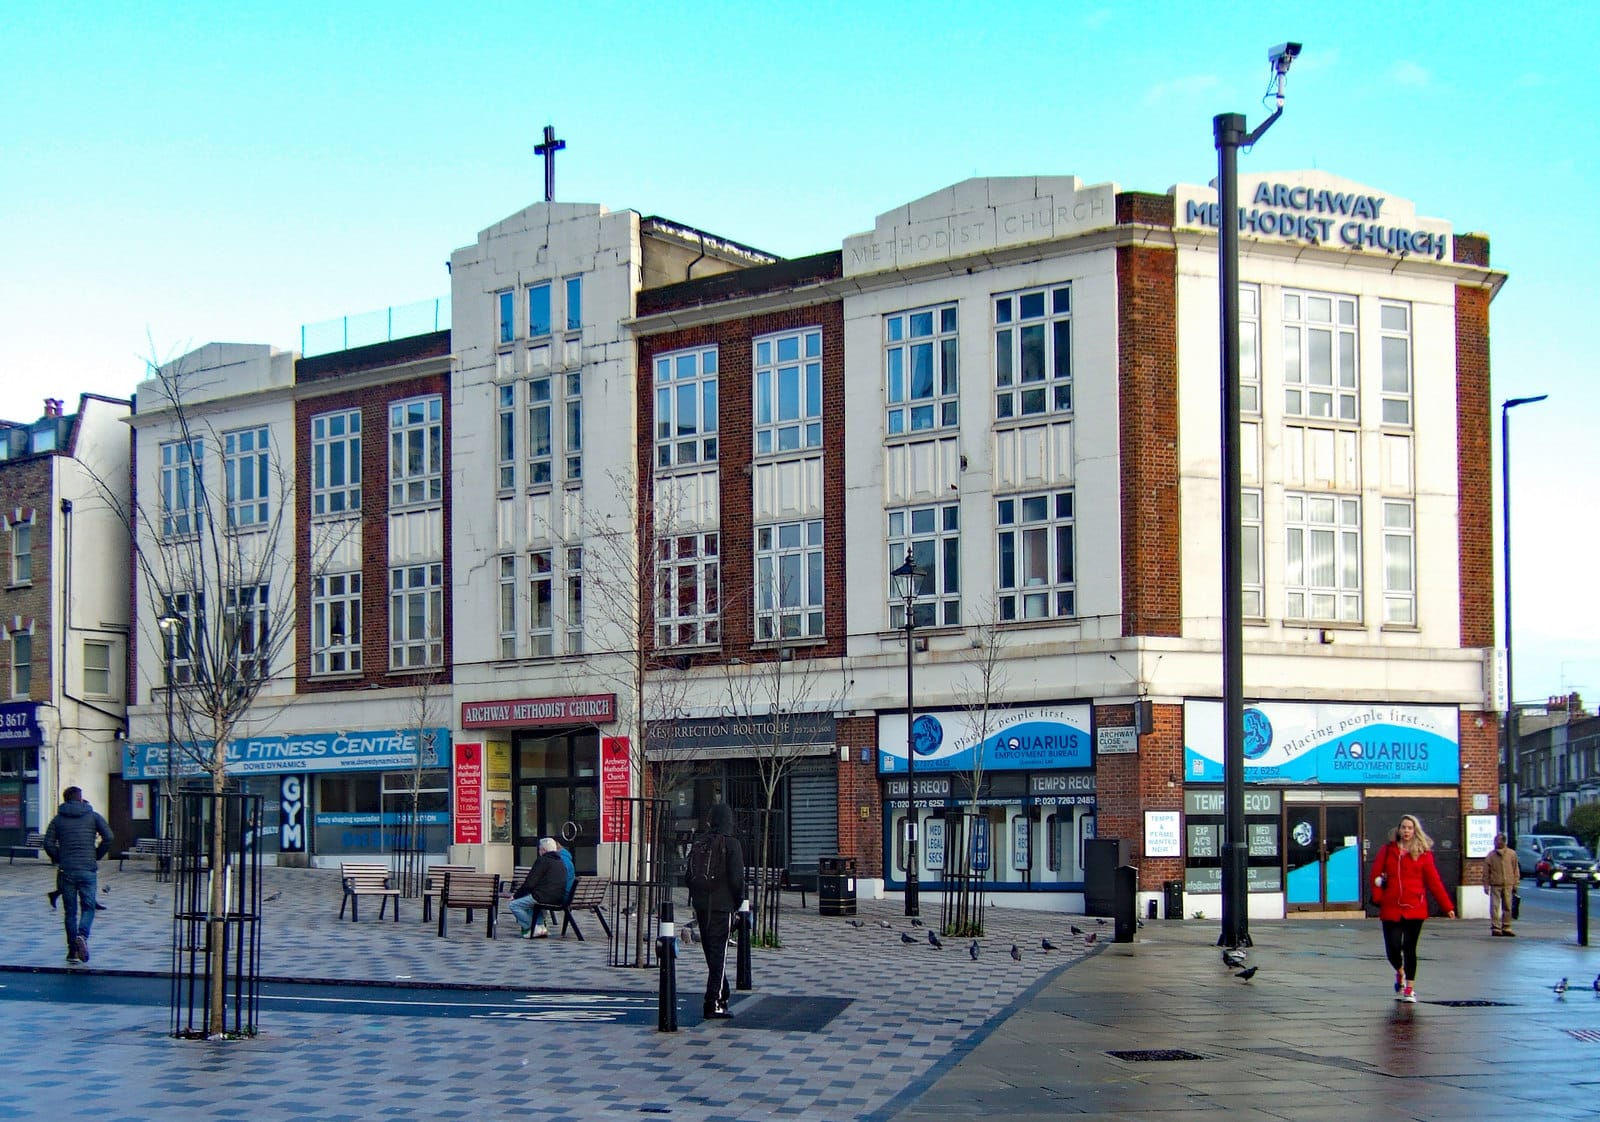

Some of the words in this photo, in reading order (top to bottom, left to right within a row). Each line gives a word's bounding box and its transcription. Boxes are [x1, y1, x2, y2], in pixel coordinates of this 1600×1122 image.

[1254, 181, 1385, 220] ARCHWAY
[851, 222, 985, 266] METHODIST
[1003, 198, 1104, 236] CHURCH
[1186, 199, 1335, 241] MEHODIST
[1339, 221, 1446, 256] CHURCH
[465, 706, 510, 722] ARCHWAY
[513, 703, 567, 720] METHODIST
[569, 699, 609, 717] CHURCH
[6, 712, 27, 728] 8617
[998, 709, 1035, 728] people
[733, 721, 790, 736] BOUTIQUE
[1282, 725, 1334, 756] Placing
[1338, 708, 1383, 731] people
[246, 740, 327, 759] FITNESS
[331, 735, 416, 755] CENTRE
[995, 734, 1079, 751] AQUARIUS
[1099, 737, 1121, 745] CLOSE
[994, 750, 1047, 760] EMPLOYMENT
[1048, 749, 1079, 758] BUREAU
[1334, 741, 1428, 760] AQUARIUS
[266, 760, 307, 769] DYNAMICS
[1260, 767, 1280, 776] 6252
[1334, 761, 1393, 771] EMPLOYMENT
[1395, 761, 1428, 772] BUREAU
[920, 779, 949, 795] REQ'D
[1032, 776, 1066, 791] TEMPS
[282, 776, 302, 849] GYM
[929, 824, 942, 836] MED
[1195, 826, 1209, 836] EXP
[1256, 826, 1270, 835] MED
[927, 838, 943, 850] LEGAL
[1252, 836, 1273, 845] LEGAL
[928, 852, 943, 863] SECS
